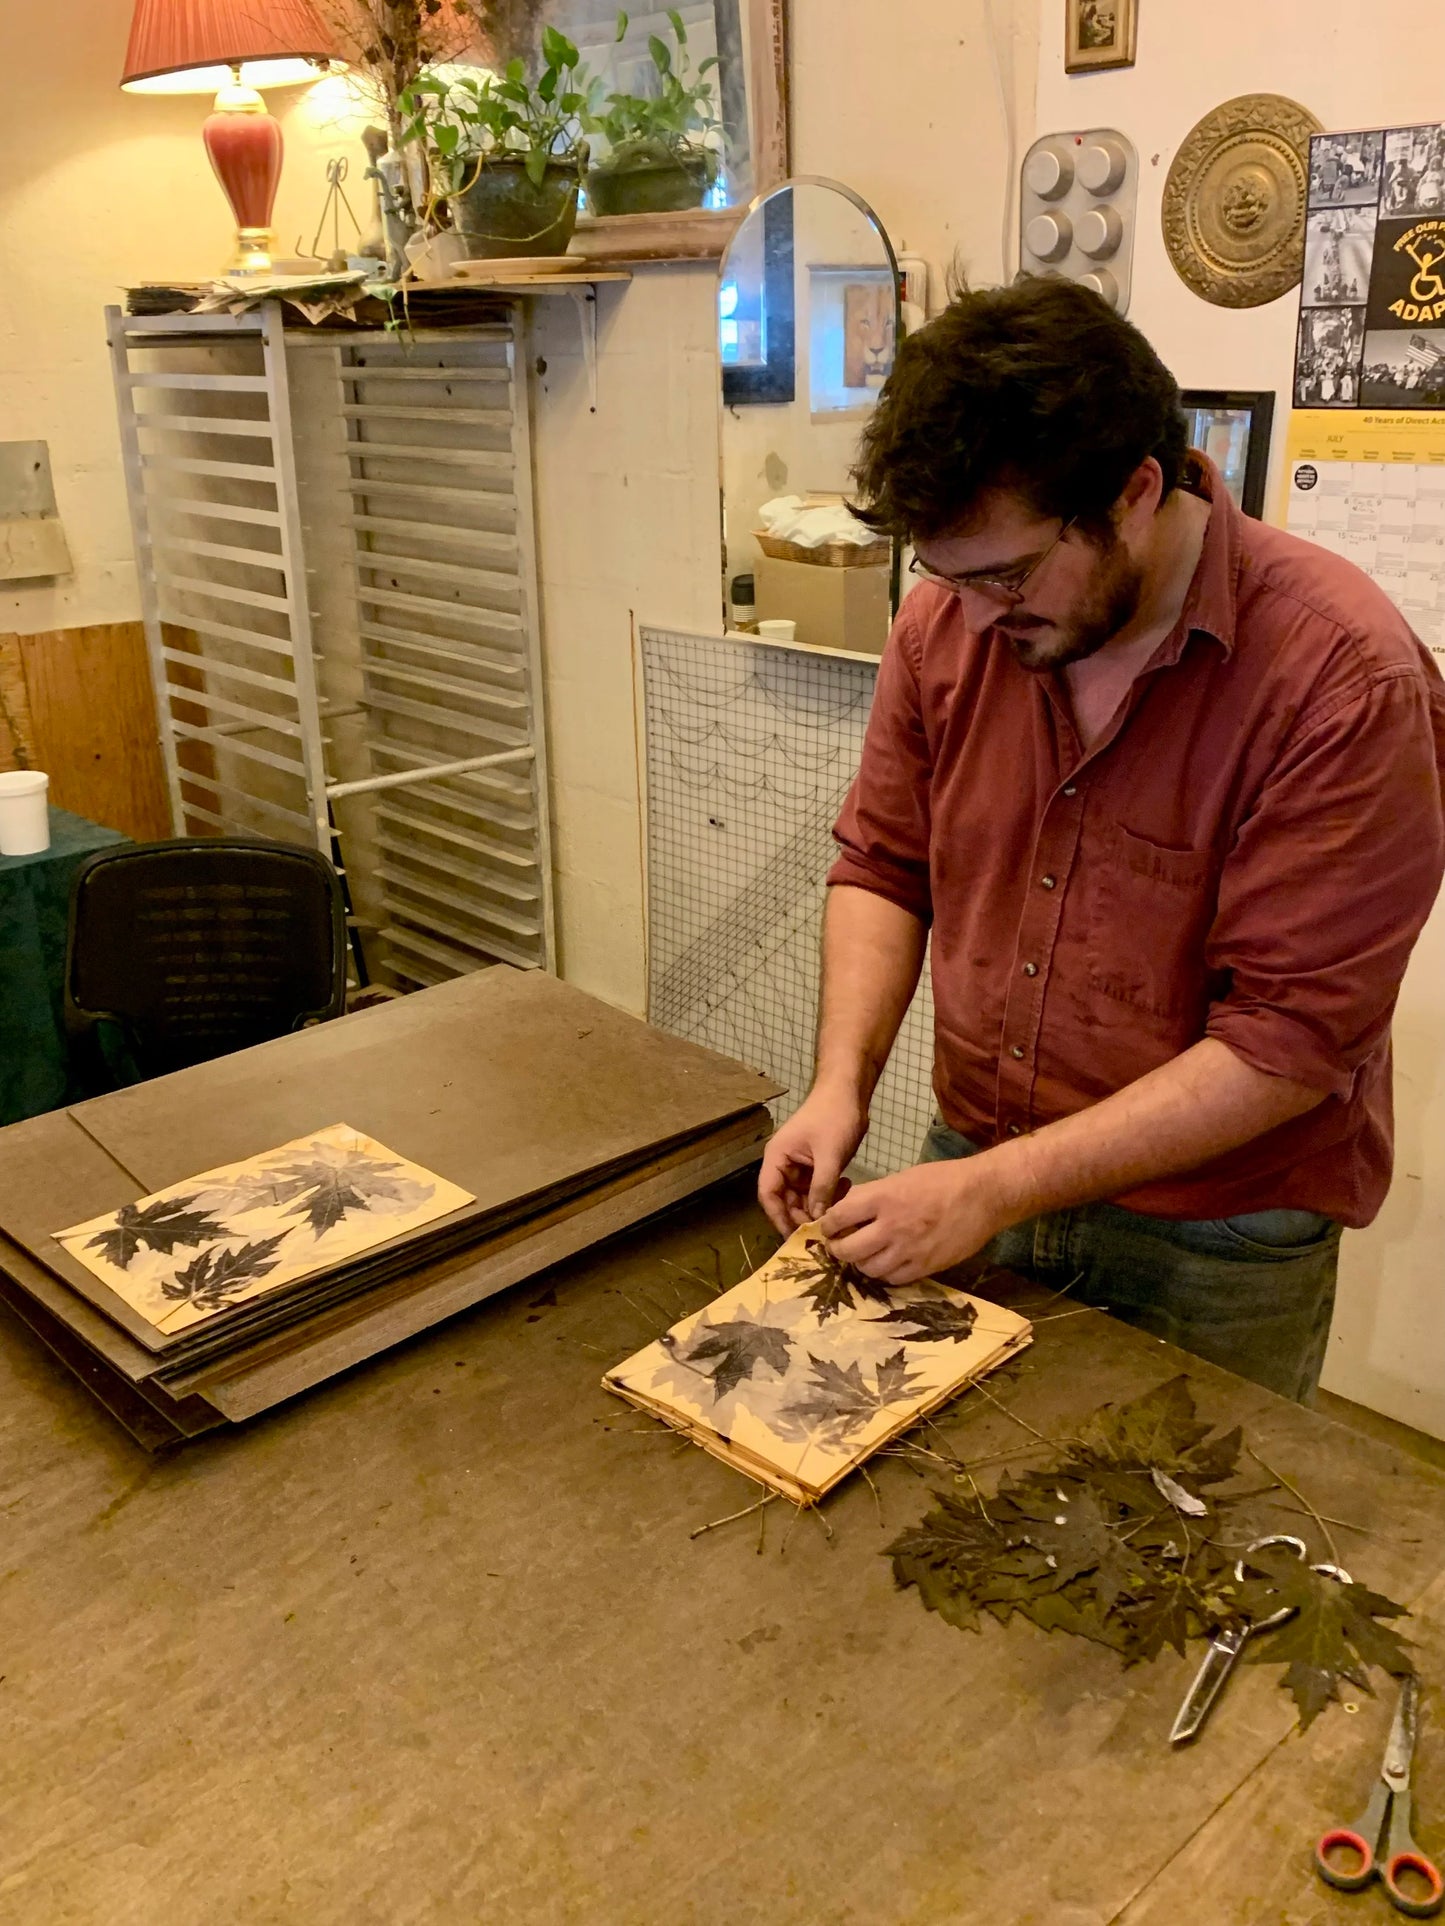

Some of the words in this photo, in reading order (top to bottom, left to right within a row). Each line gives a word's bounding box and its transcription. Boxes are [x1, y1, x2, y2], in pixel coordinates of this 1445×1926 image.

[1393, 229, 1415, 251] FREE
[1415, 221, 1438, 233] OUR
[1388, 299, 1445, 322] ADAP
[1363, 416, 1374, 424] 40
[1375, 417, 1394, 425] Years
[1396, 417, 1405, 425] of
[1405, 417, 1430, 425] Direct
[1327, 435, 1344, 443] JULY
